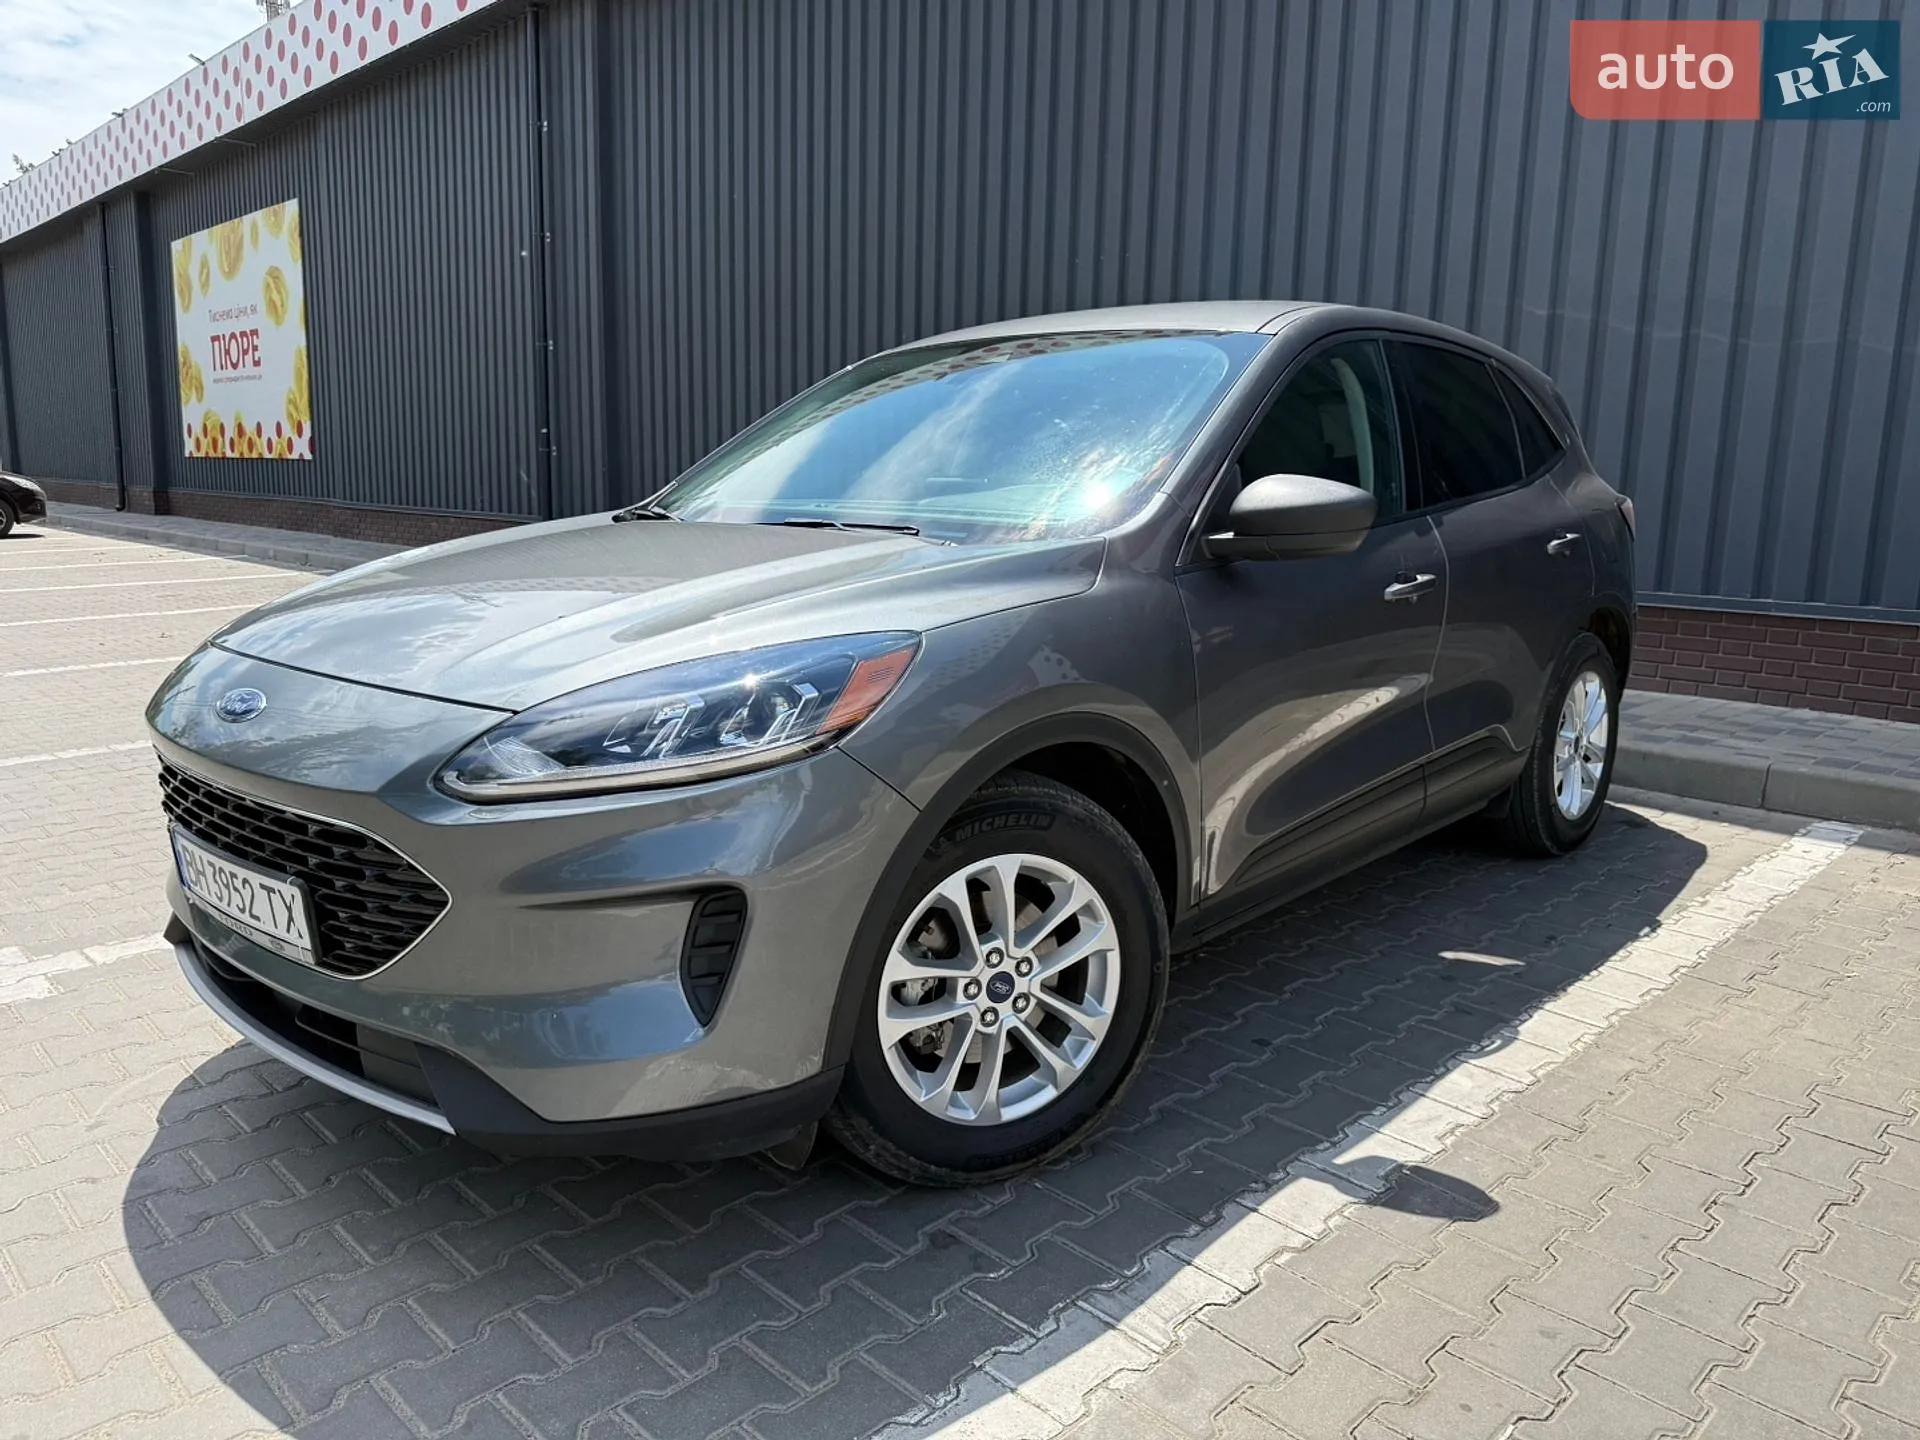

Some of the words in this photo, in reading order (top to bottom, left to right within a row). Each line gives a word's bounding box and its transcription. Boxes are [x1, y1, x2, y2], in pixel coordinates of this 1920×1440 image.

[210, 328, 261, 372] ПЮРЕ
[956, 812, 1050, 842] MICHELIN
[207, 860, 262, 923] 3952
[259, 882, 303, 940] TX
